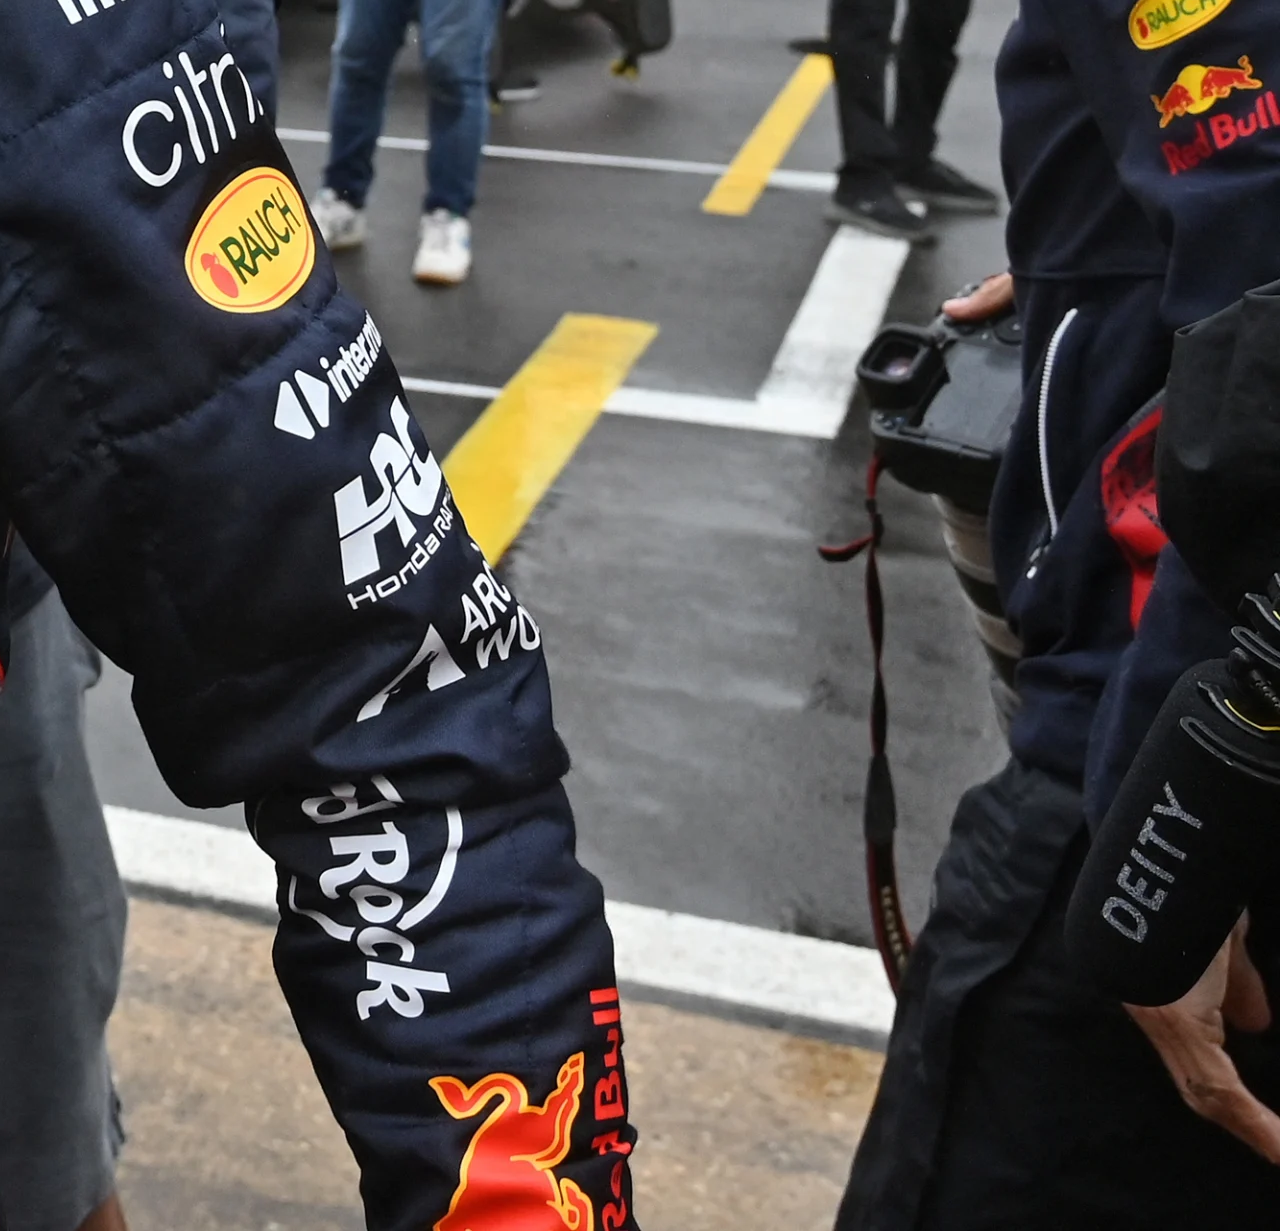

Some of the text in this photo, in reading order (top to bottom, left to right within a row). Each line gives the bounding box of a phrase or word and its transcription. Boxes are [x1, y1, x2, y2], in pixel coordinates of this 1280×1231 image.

[219, 187, 302, 285] RAUCH
[346, 531, 441, 610] Honda
[319, 821, 451, 1021] Rock
[1101, 780, 1204, 944] DEITY
